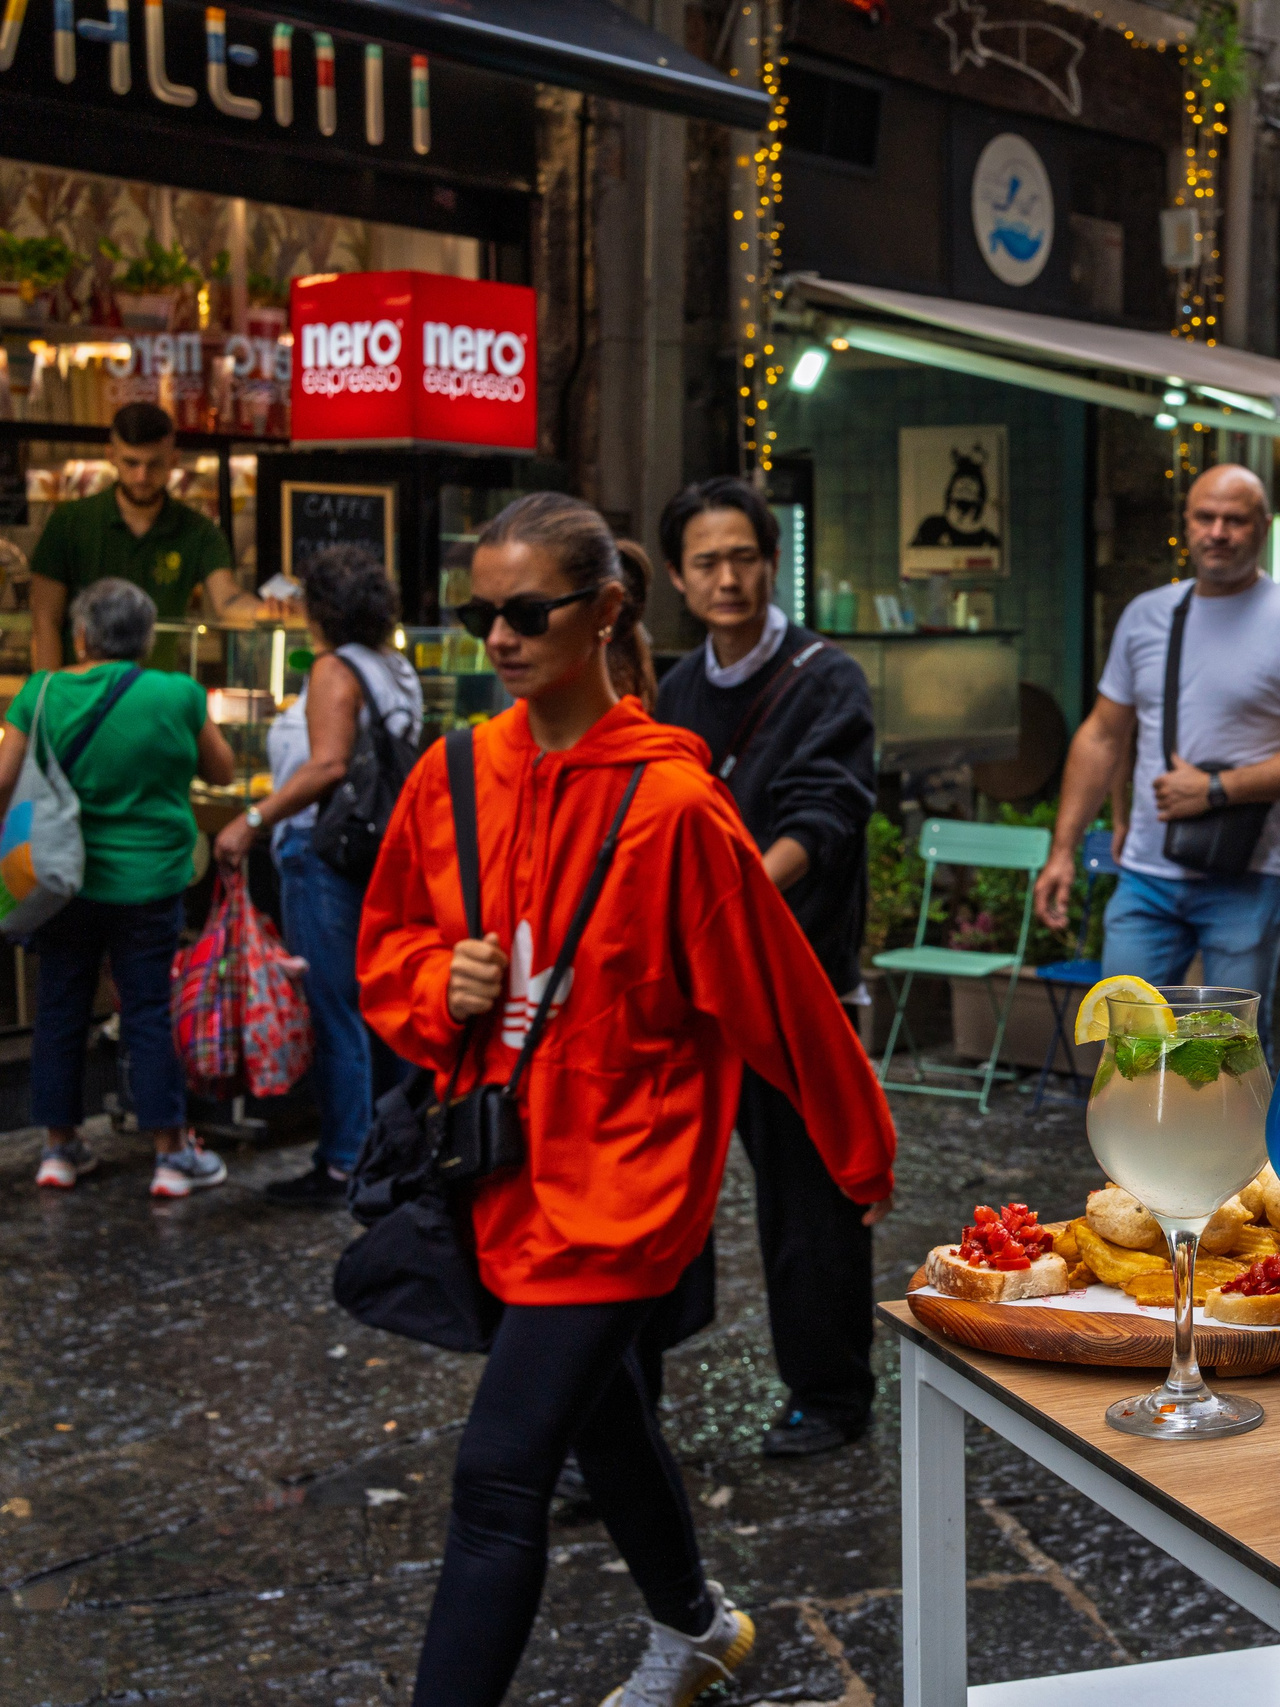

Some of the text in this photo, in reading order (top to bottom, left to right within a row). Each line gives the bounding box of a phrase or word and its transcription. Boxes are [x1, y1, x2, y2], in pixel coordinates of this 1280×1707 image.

[302, 319, 401, 368] nero
[423, 321, 525, 377] nero
[302, 364, 402, 399] espresso
[423, 366, 526, 403] espresso
